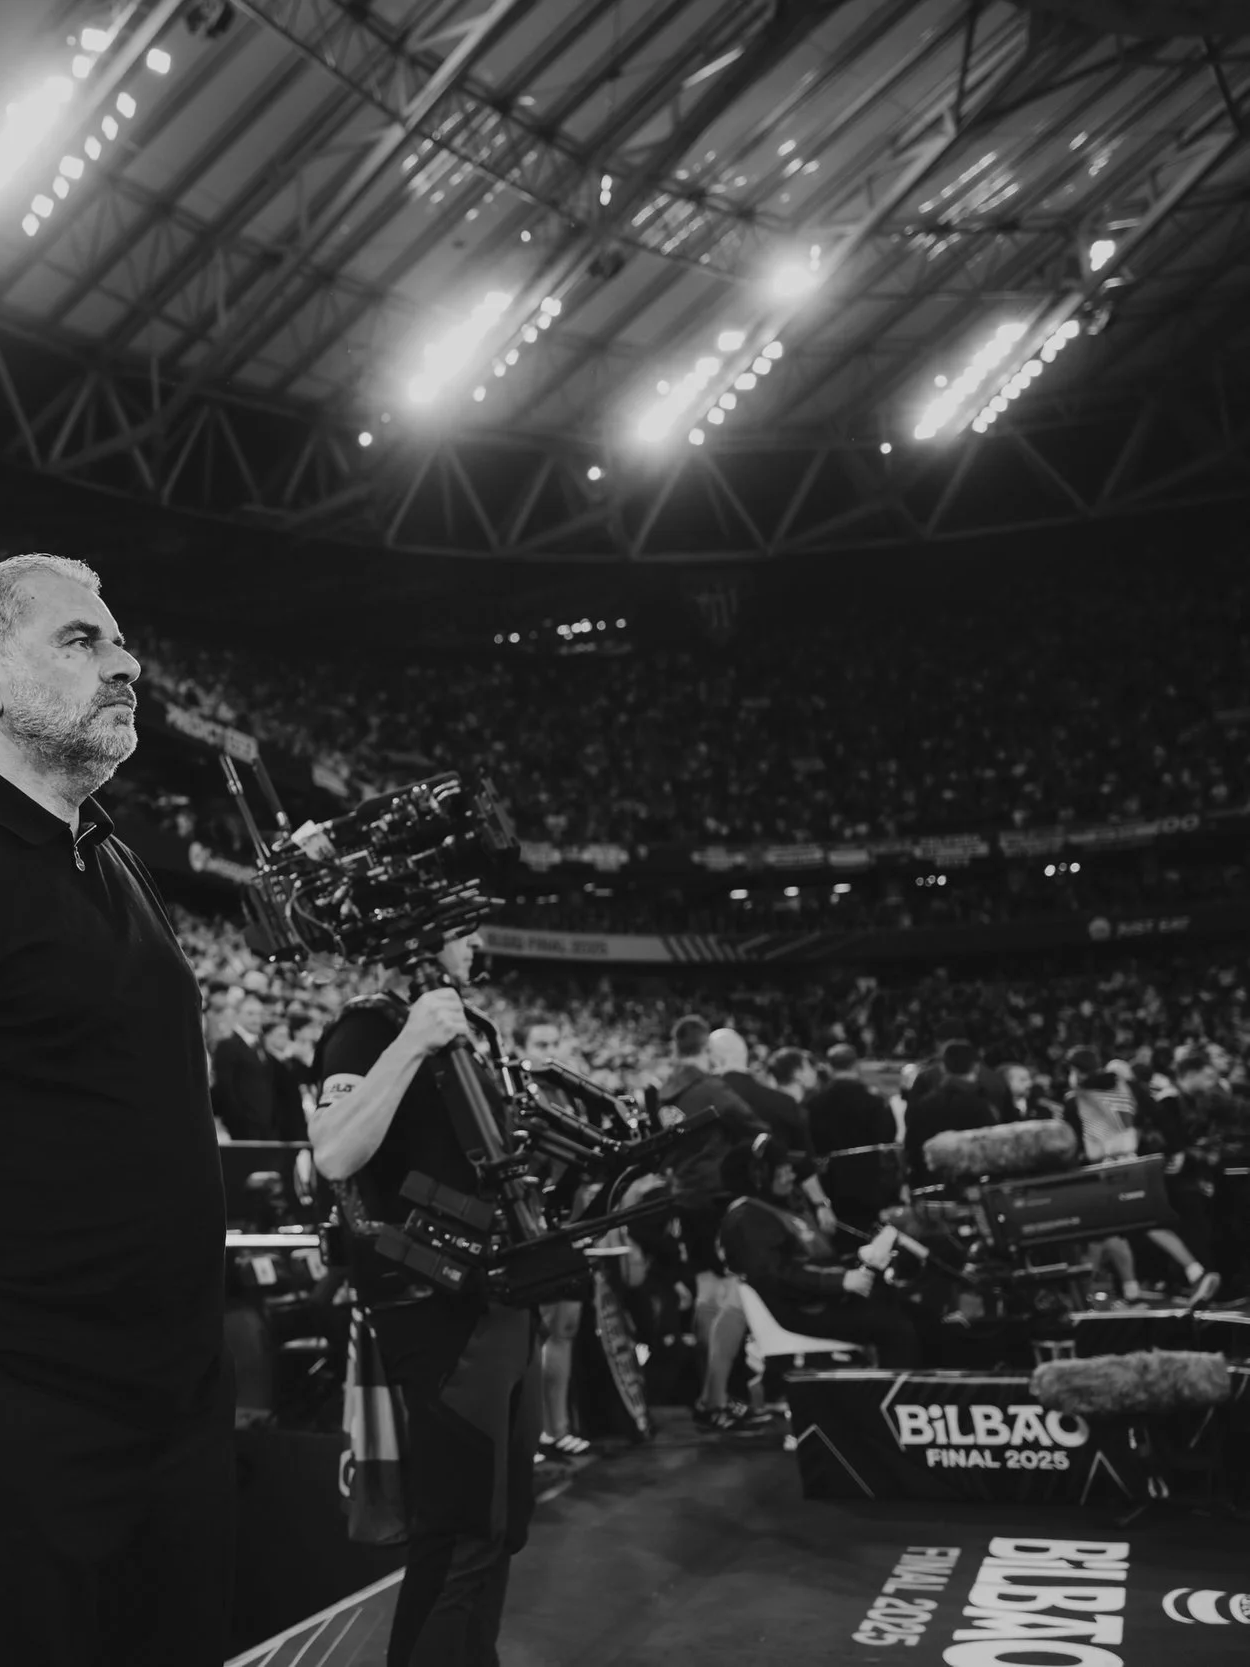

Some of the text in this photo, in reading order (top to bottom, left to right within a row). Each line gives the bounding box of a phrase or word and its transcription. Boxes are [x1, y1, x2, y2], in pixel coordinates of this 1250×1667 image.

[925, 1448, 1071, 1471] FINAL 2025
[851, 1546, 962, 1647] FINAL 2025
